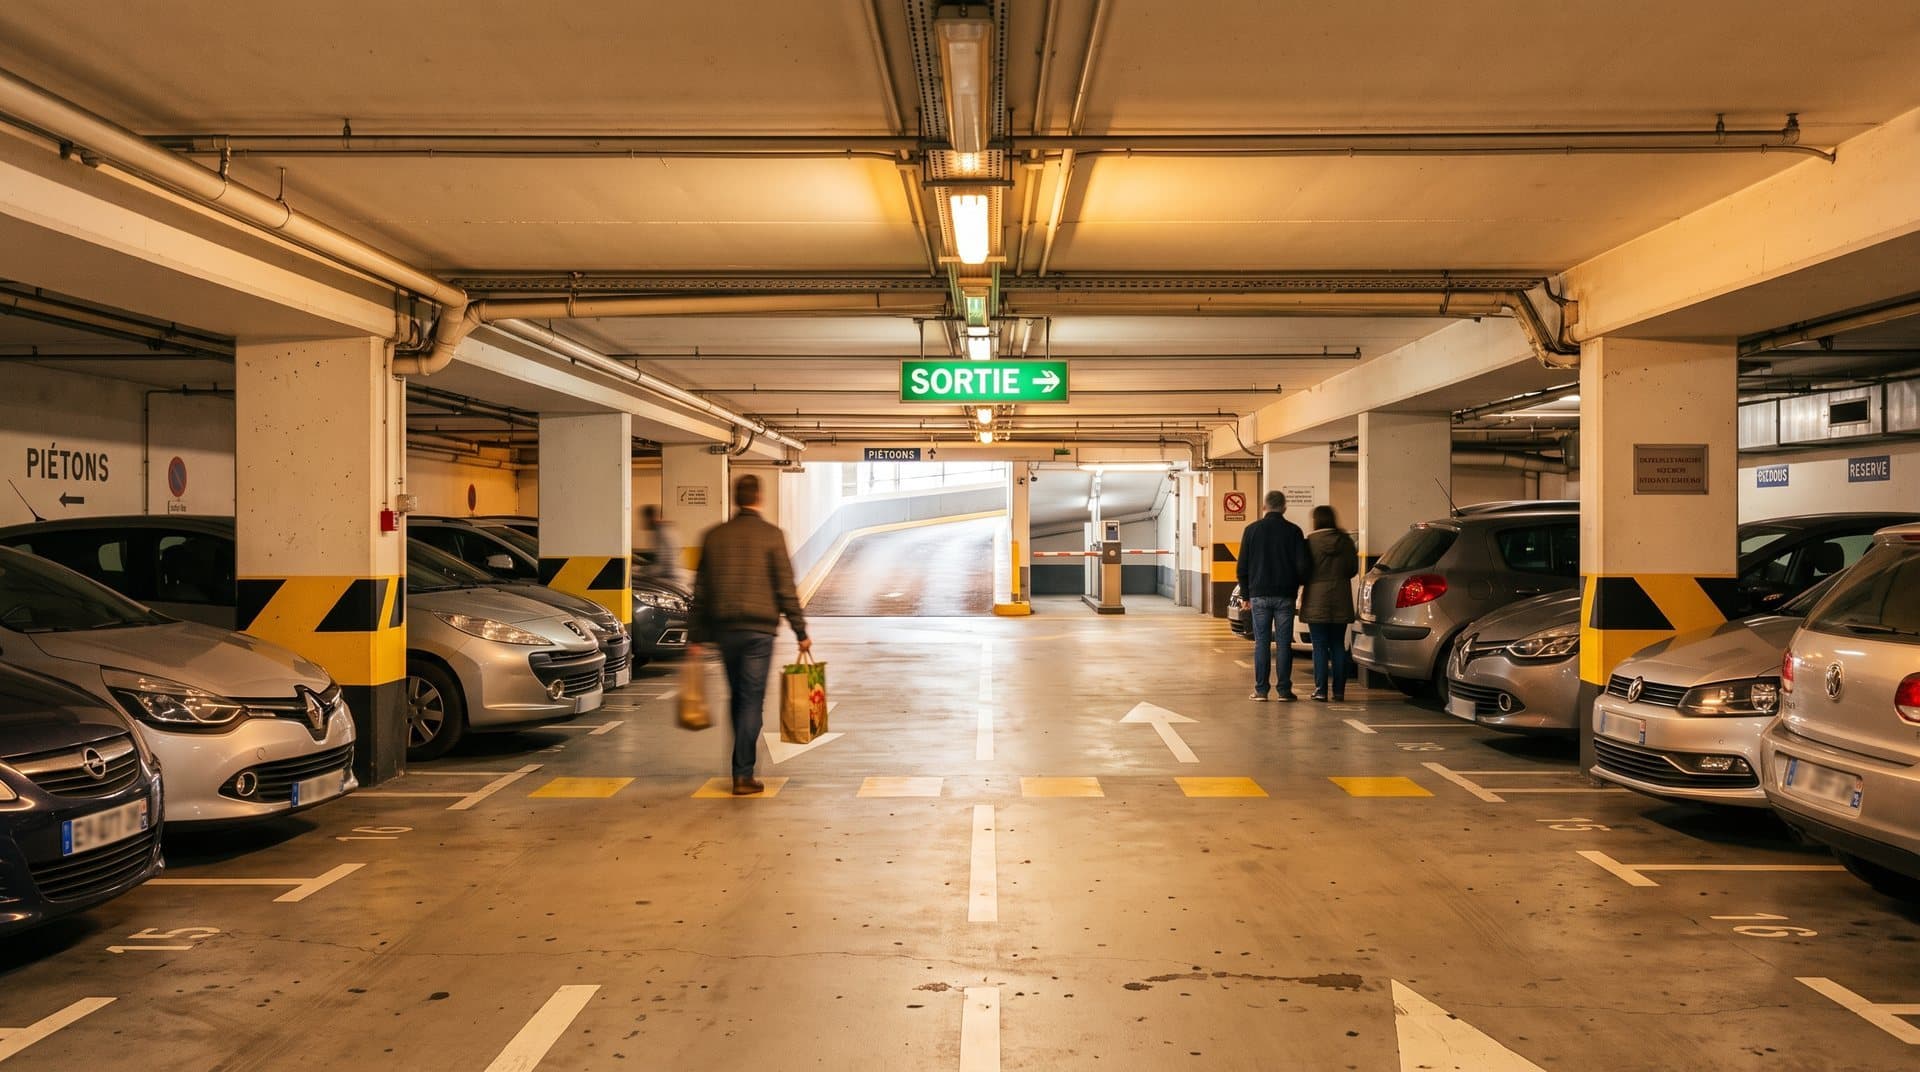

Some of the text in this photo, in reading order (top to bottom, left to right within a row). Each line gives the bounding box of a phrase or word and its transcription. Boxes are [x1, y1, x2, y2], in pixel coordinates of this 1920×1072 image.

[911, 368, 1021, 395] SORTIE
[27, 442, 109, 482] PIÉTONS
[105, 926, 221, 954] 15
